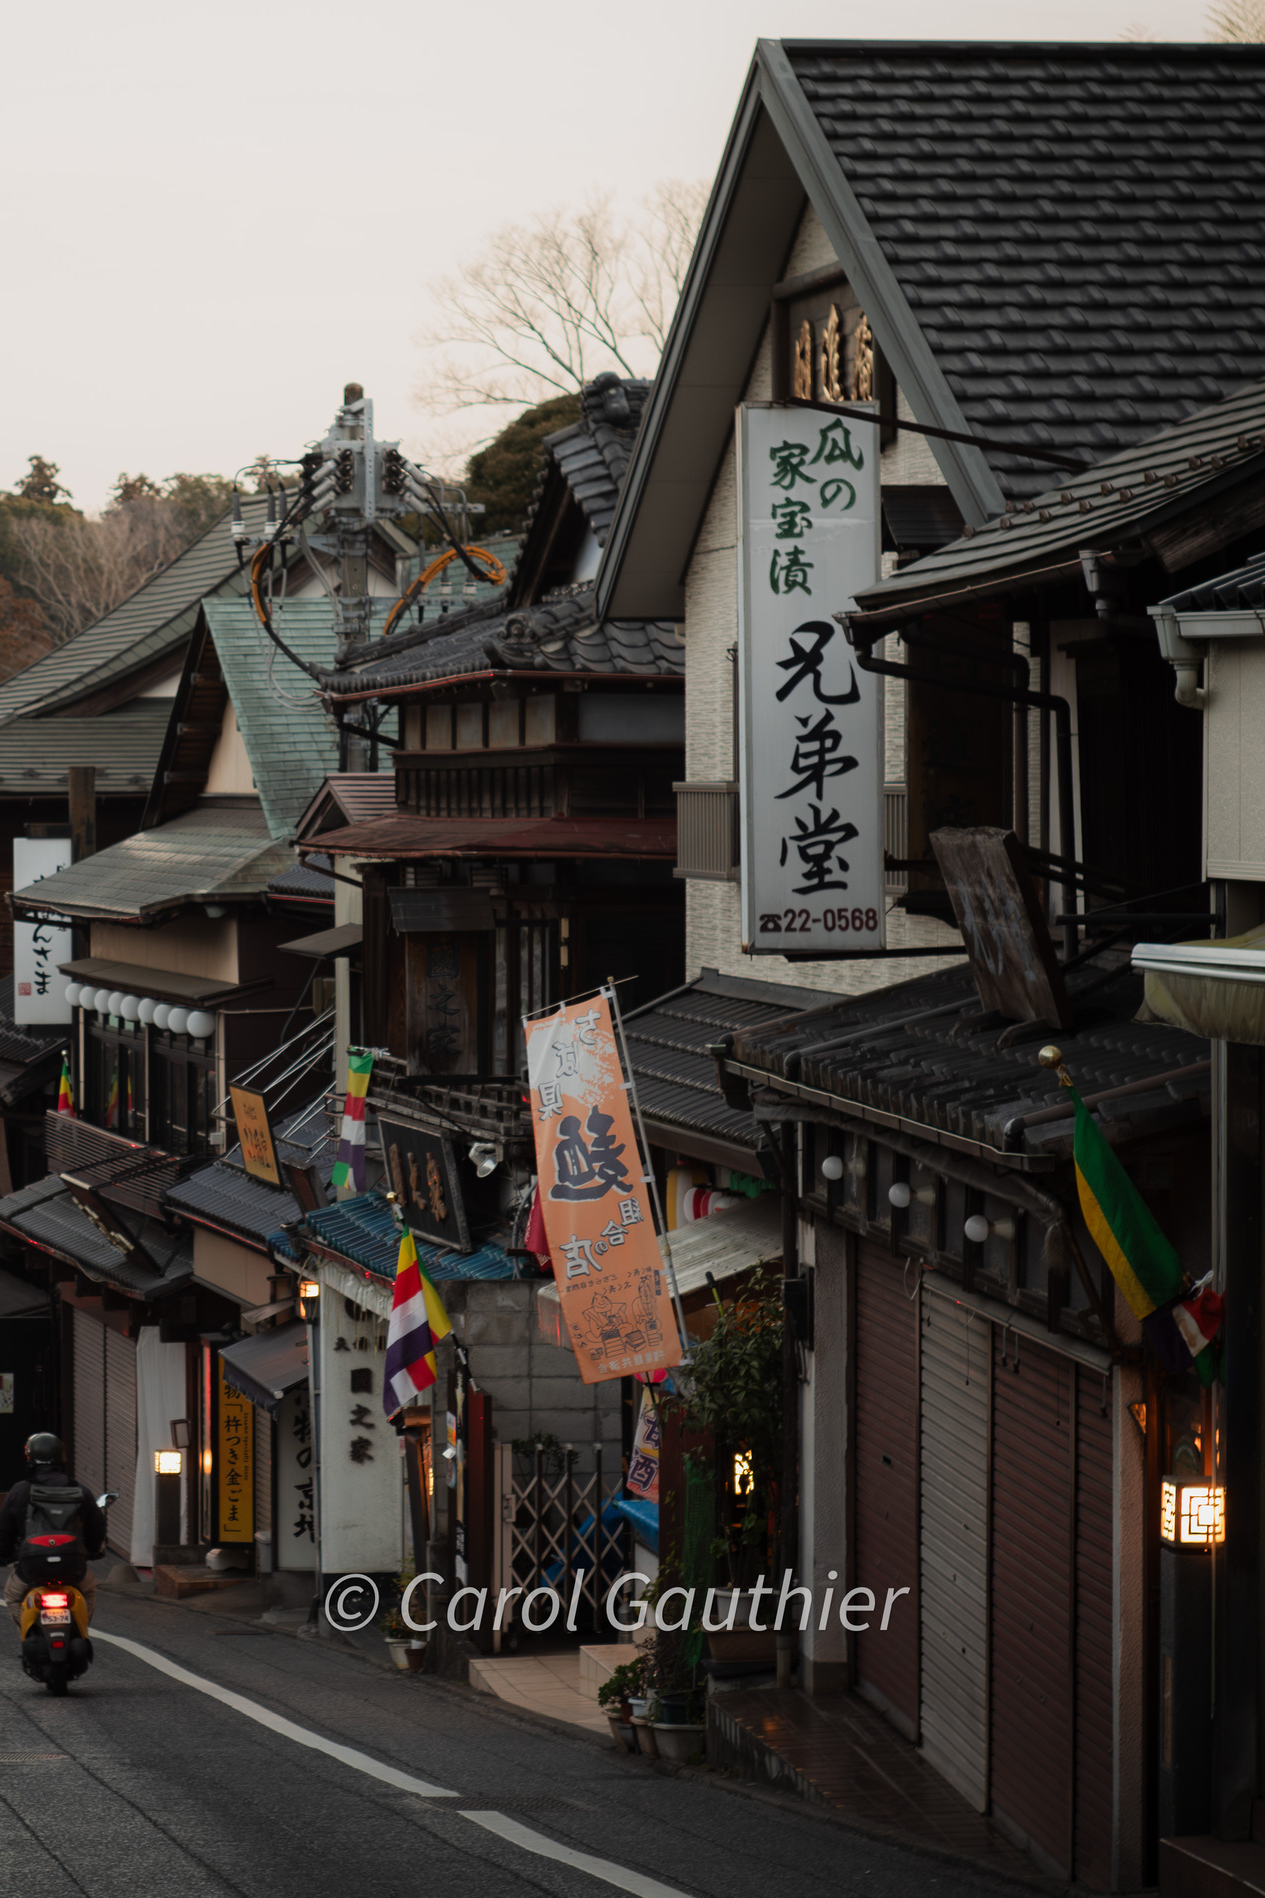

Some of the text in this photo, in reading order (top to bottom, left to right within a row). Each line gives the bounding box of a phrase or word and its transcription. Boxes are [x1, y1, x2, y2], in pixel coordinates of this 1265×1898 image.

[768, 439, 818, 597] 家宝漬
[811, 417, 865, 513] 瓜の
[774, 619, 861, 897] 兄弟堂
[783, 908, 879, 934] 22-0568
